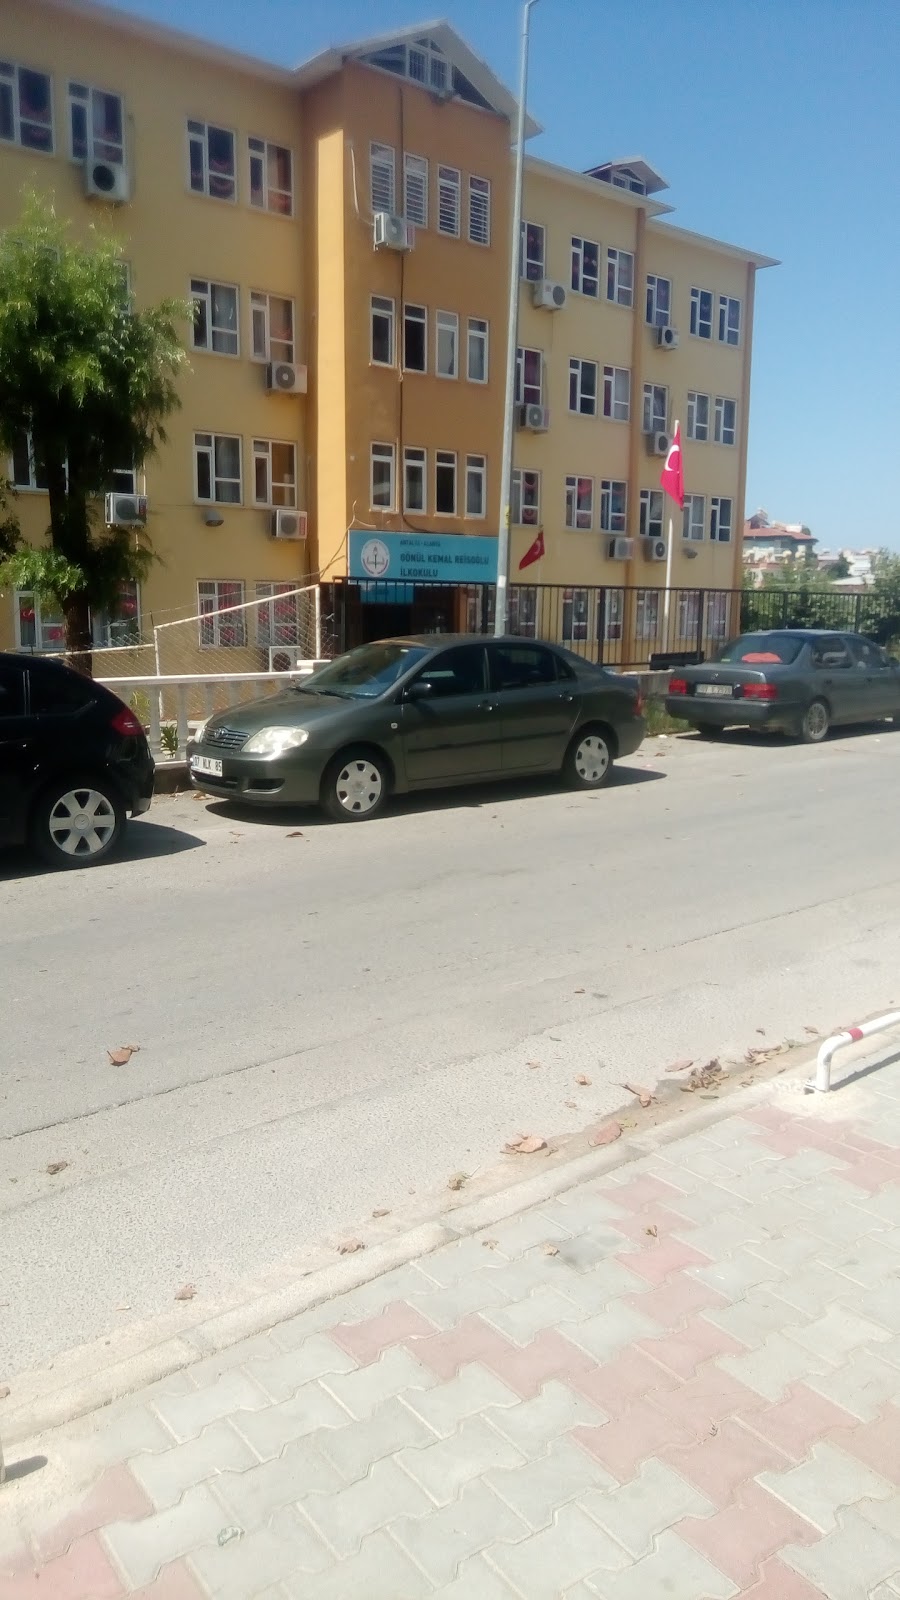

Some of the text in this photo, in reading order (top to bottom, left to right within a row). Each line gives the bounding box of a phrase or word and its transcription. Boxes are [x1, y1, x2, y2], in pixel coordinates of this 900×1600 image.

[400, 551, 425, 562] GÖNÜL
[428, 554, 452, 563] KEMAL
[400, 566, 438, 577] İLKOKULU
